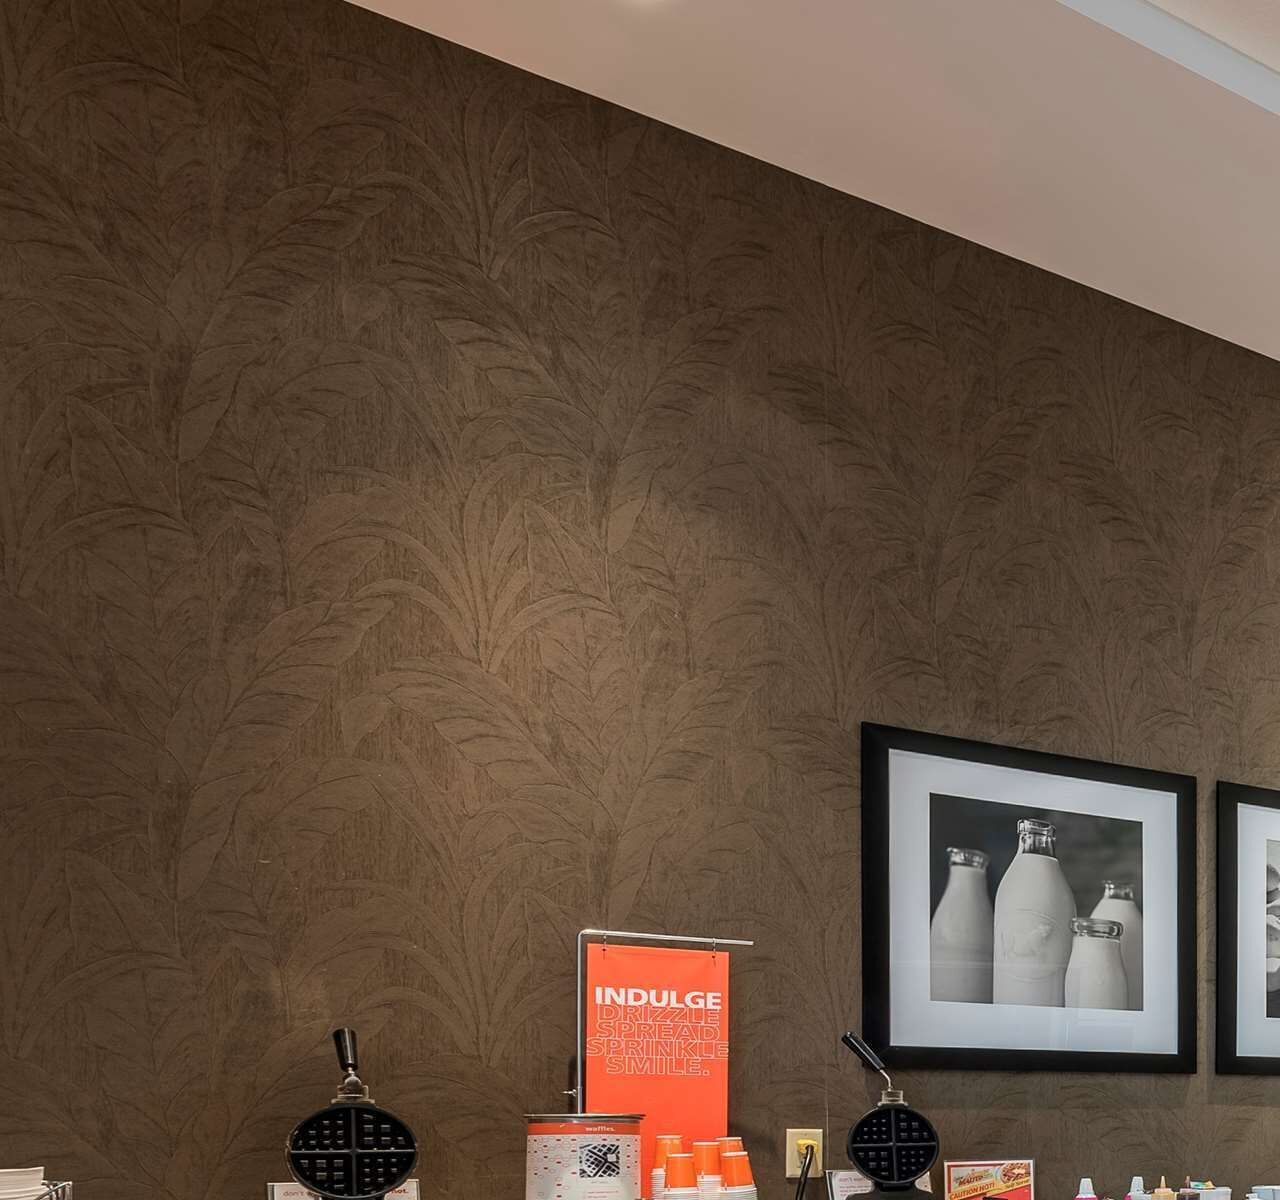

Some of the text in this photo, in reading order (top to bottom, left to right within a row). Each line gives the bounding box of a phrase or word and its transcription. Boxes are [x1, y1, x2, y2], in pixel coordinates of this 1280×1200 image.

[595, 986, 722, 1010] INDULGE
[596, 1004, 720, 1026] DRIZZLE
[596, 1020, 721, 1042] SPREAD
[586, 1037, 729, 1060] SPRINKLE
[605, 1055, 711, 1077] SMILE.
[949, 1185, 978, 1200] CAUTION
